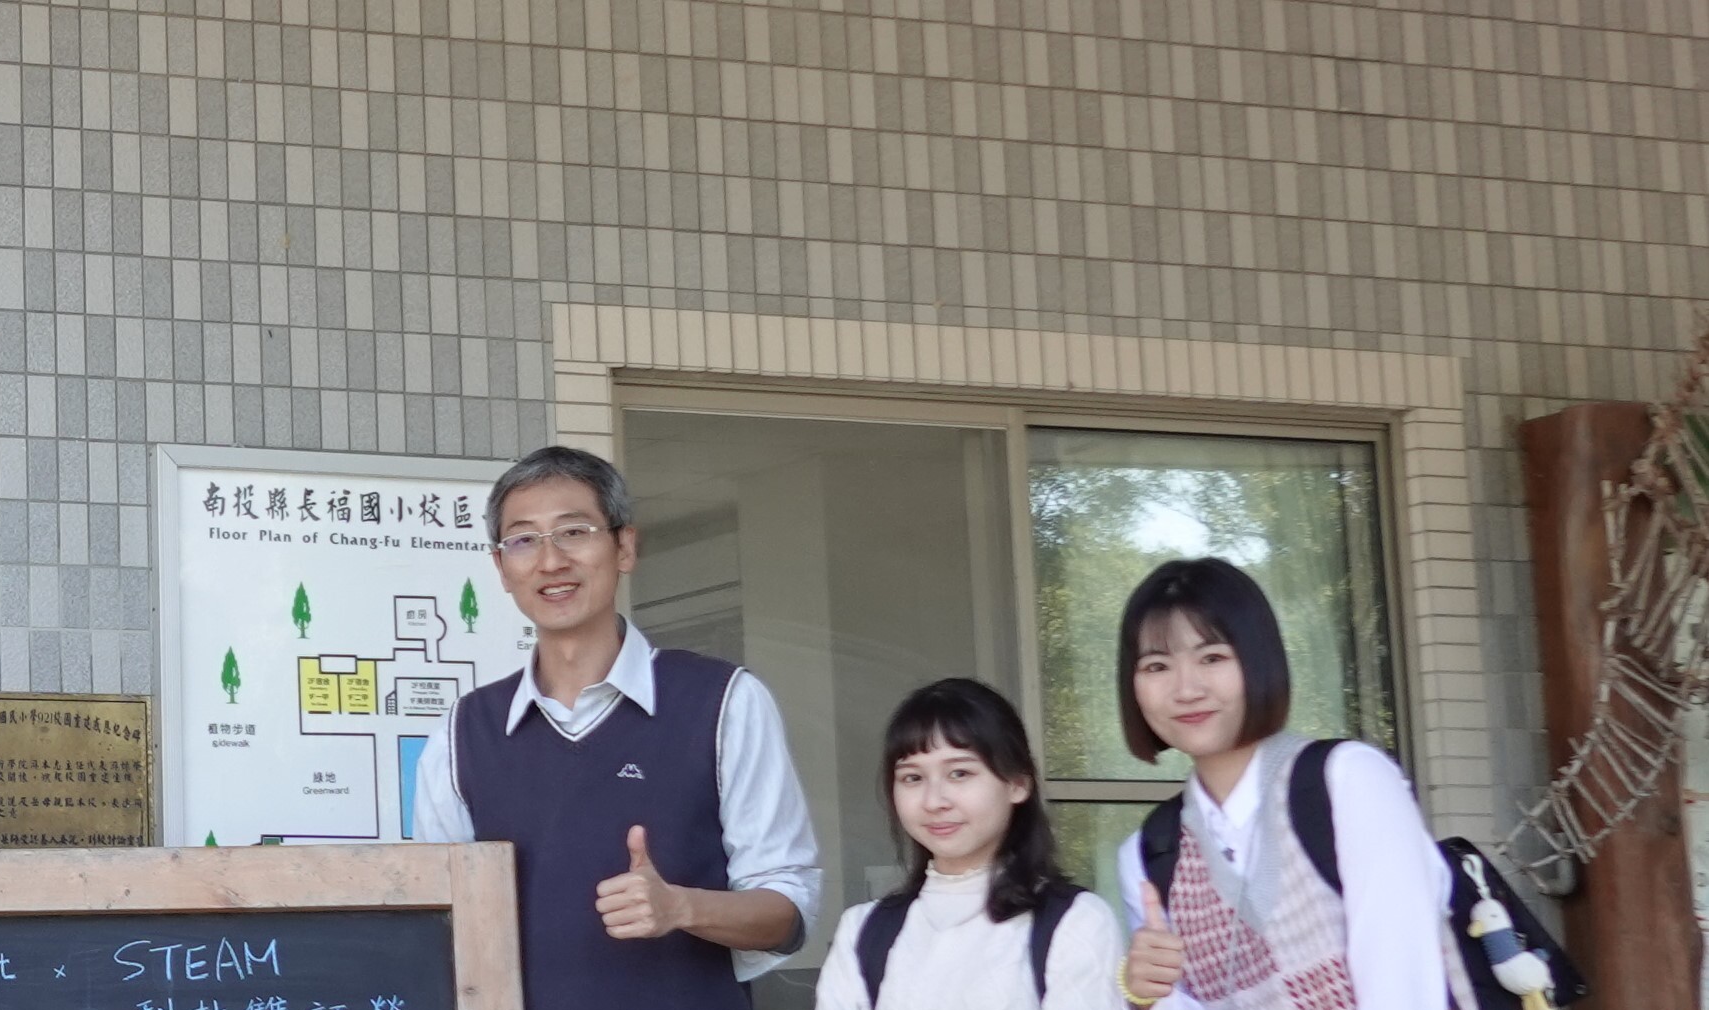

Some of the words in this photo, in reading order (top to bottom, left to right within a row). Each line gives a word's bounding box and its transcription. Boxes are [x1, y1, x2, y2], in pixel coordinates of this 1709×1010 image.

[203, 481, 487, 530] 南投縣長福國小校區
[209, 527, 247, 541] Floor
[259, 530, 292, 543] Plan
[302, 532, 318, 544] of
[329, 533, 400, 550] Chang-Fu
[113, 939, 282, 983] STEAM
